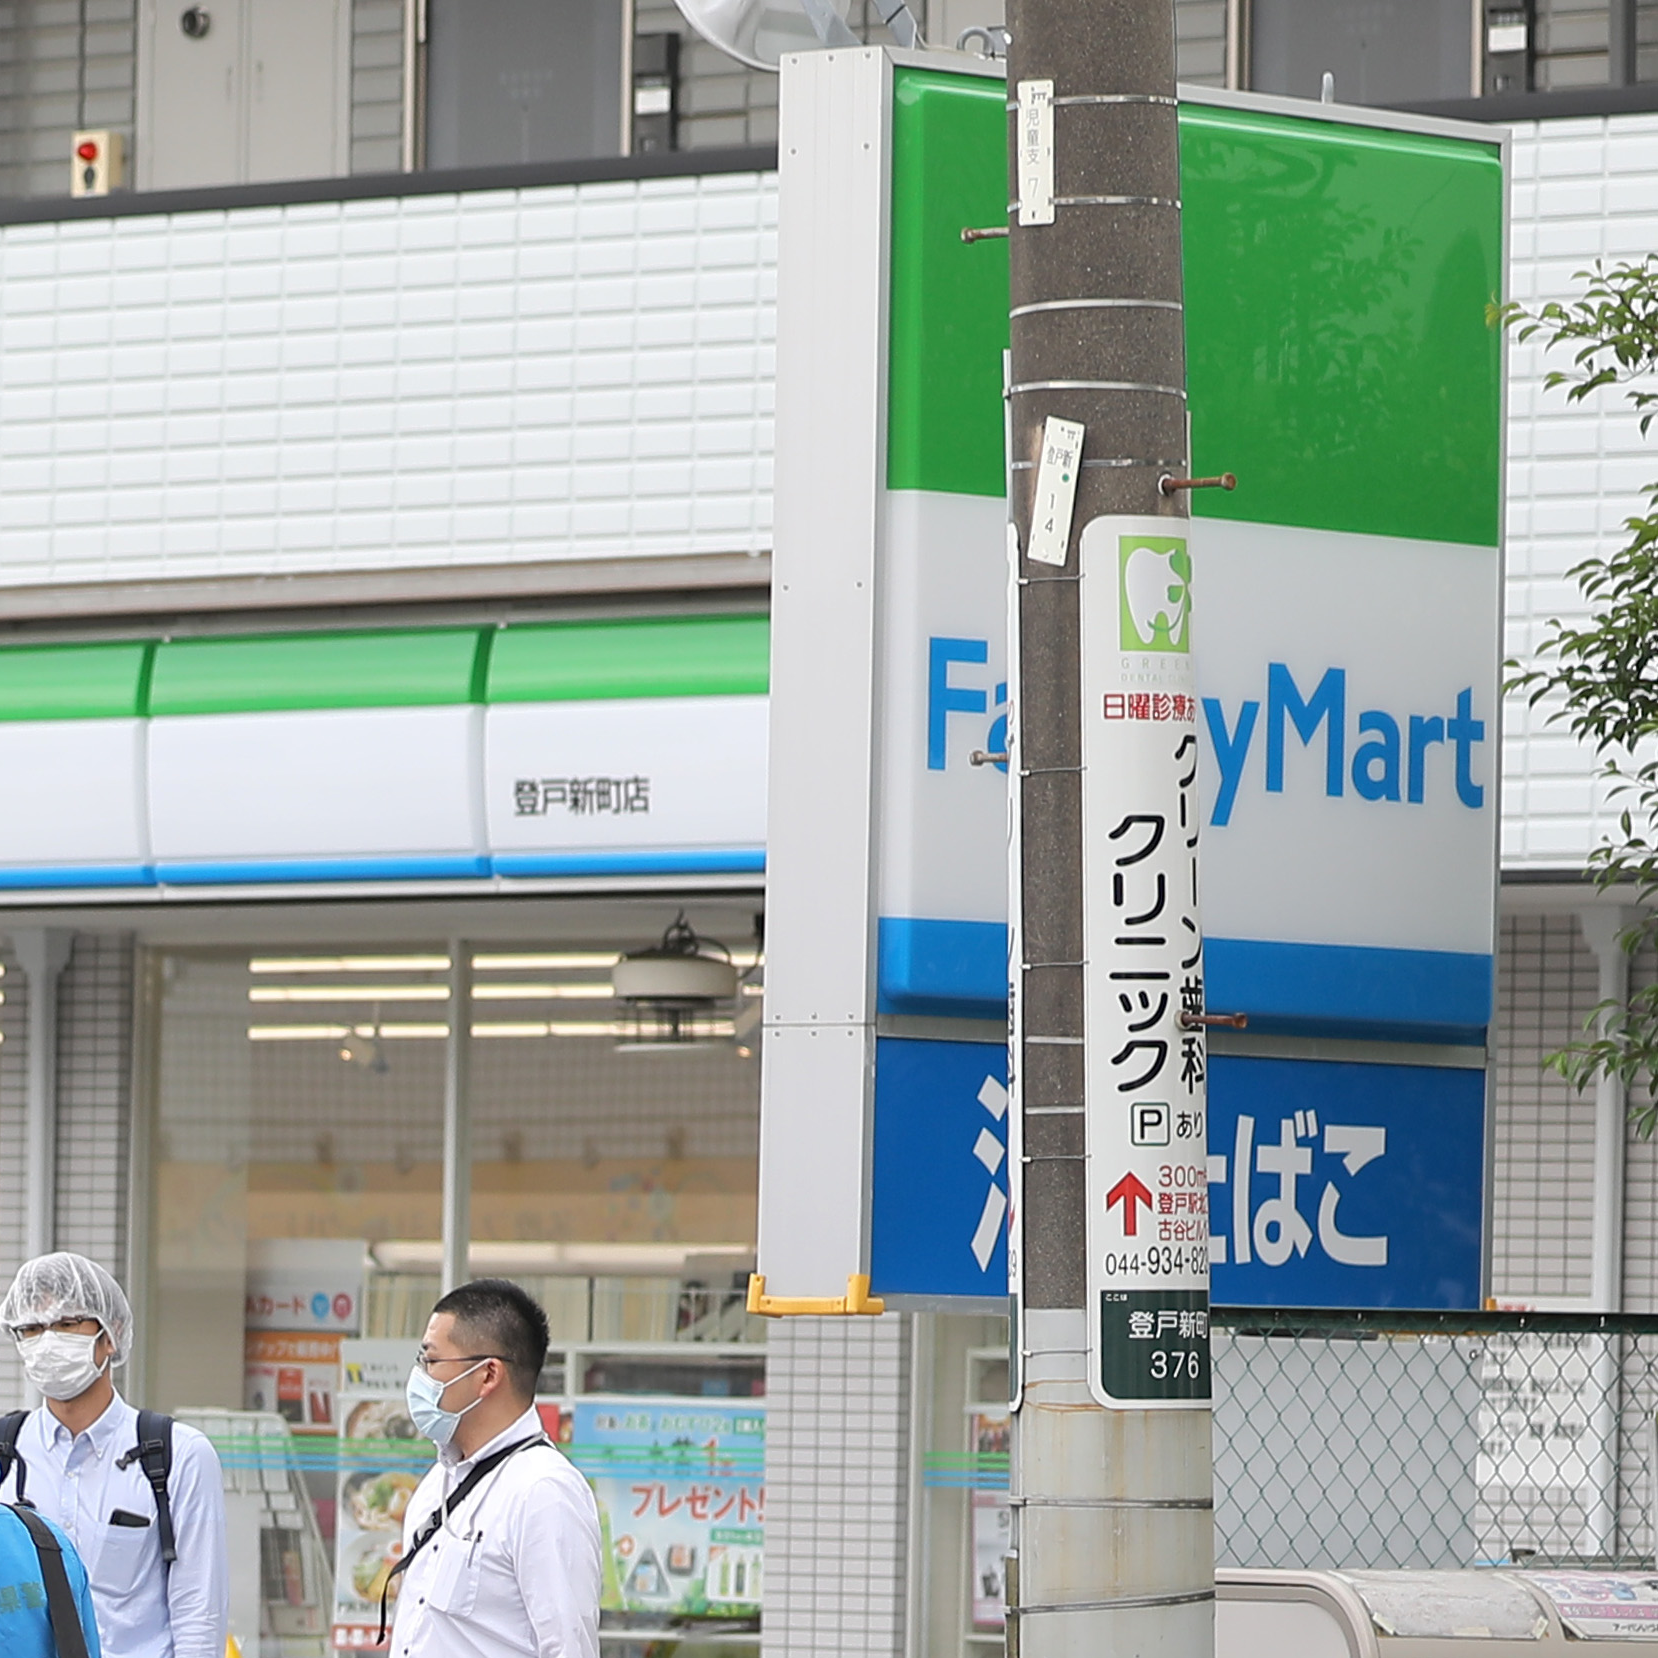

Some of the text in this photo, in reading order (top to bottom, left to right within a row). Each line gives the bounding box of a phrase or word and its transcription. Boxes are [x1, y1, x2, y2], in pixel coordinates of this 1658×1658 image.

[514, 776, 650, 816] 登戸新町店
[1108, 814, 1170, 1093] クリニック
[1176, 1111, 1203, 1139] あり
[1128, 1311, 1208, 1340] 登戸新町
[1150, 1351, 1200, 1379] 376
[632, 1483, 767, 1523] プレゼント!
